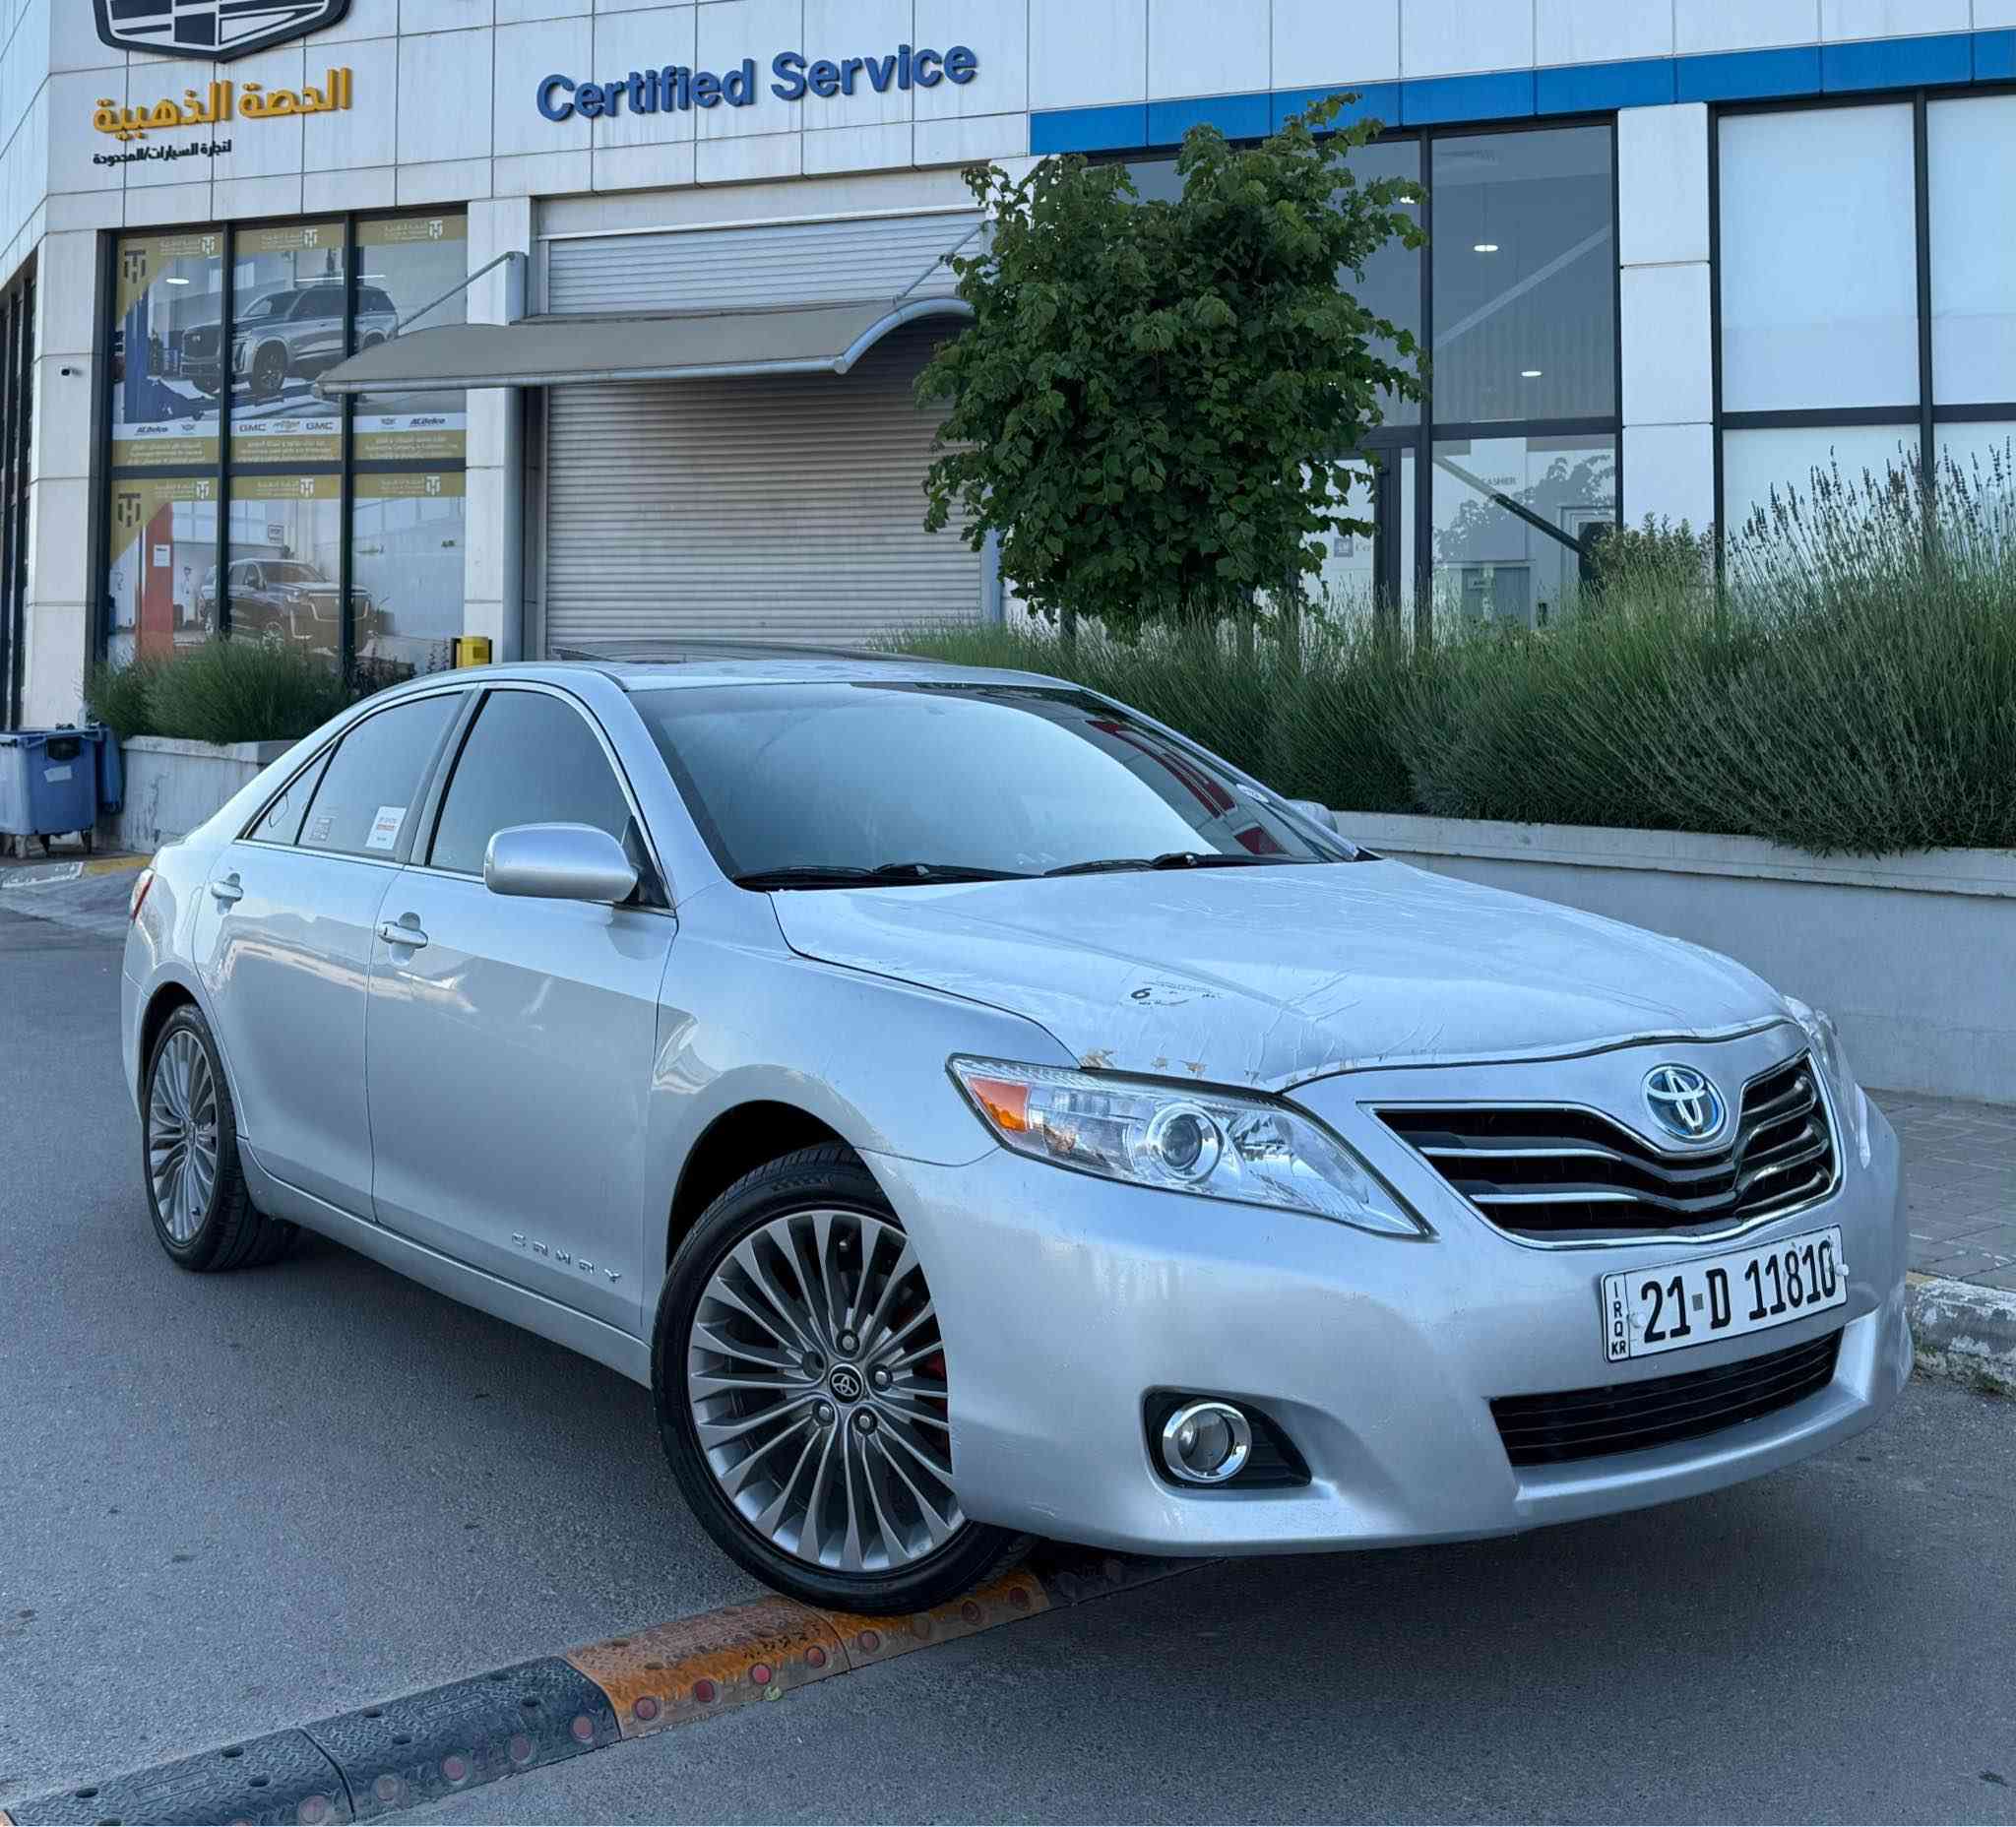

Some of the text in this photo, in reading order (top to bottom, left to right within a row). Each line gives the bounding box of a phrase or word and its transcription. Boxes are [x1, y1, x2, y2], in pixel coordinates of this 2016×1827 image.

[94, 67, 352, 141] الحصة الذهبية
[536, 44, 977, 121] Certified Service
[239, 423, 267, 432] GMC
[305, 421, 334, 430] GMC
[1612, 1282, 1624, 1337] IRQ
[1641, 1239, 1837, 1344] 21 D 11810
[1611, 1340, 1626, 1356] KR
